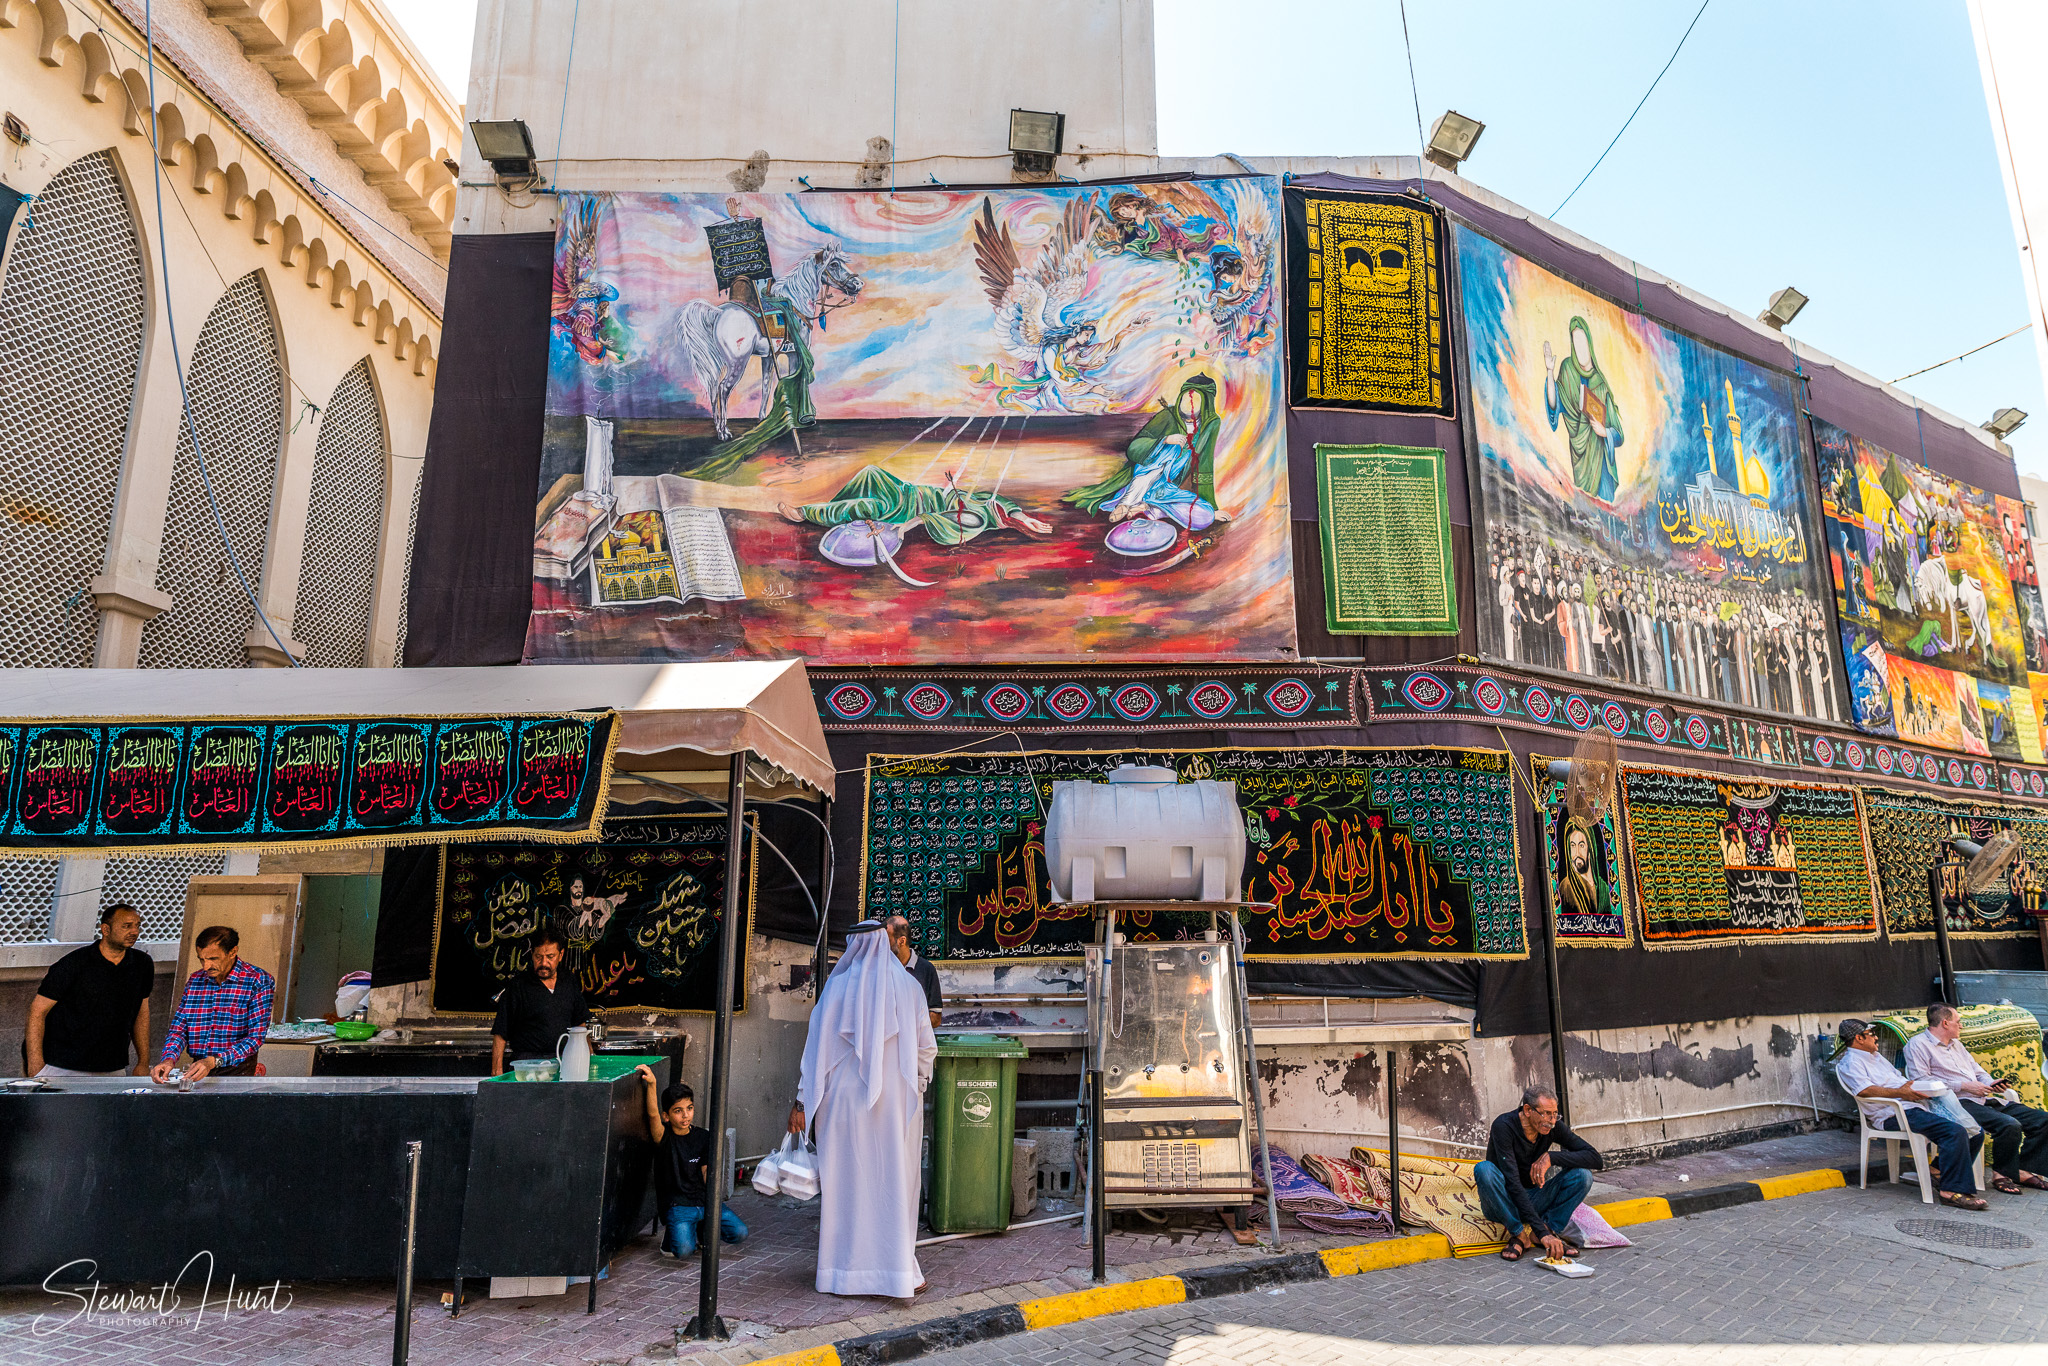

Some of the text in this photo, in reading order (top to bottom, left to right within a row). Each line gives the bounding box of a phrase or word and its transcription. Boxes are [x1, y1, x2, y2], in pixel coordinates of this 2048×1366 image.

[1697, 556, 1728, 574] الحسين
[24, 788, 83, 819] العباس
[106, 788, 164, 819] العباس
[189, 786, 248, 818] العباس
[272, 785, 332, 816] العباس
[356, 783, 416, 815] العباس
[439, 779, 499, 810] العباس
[517, 774, 578, 805] العباس
[1419, 845, 1458, 945] يا
